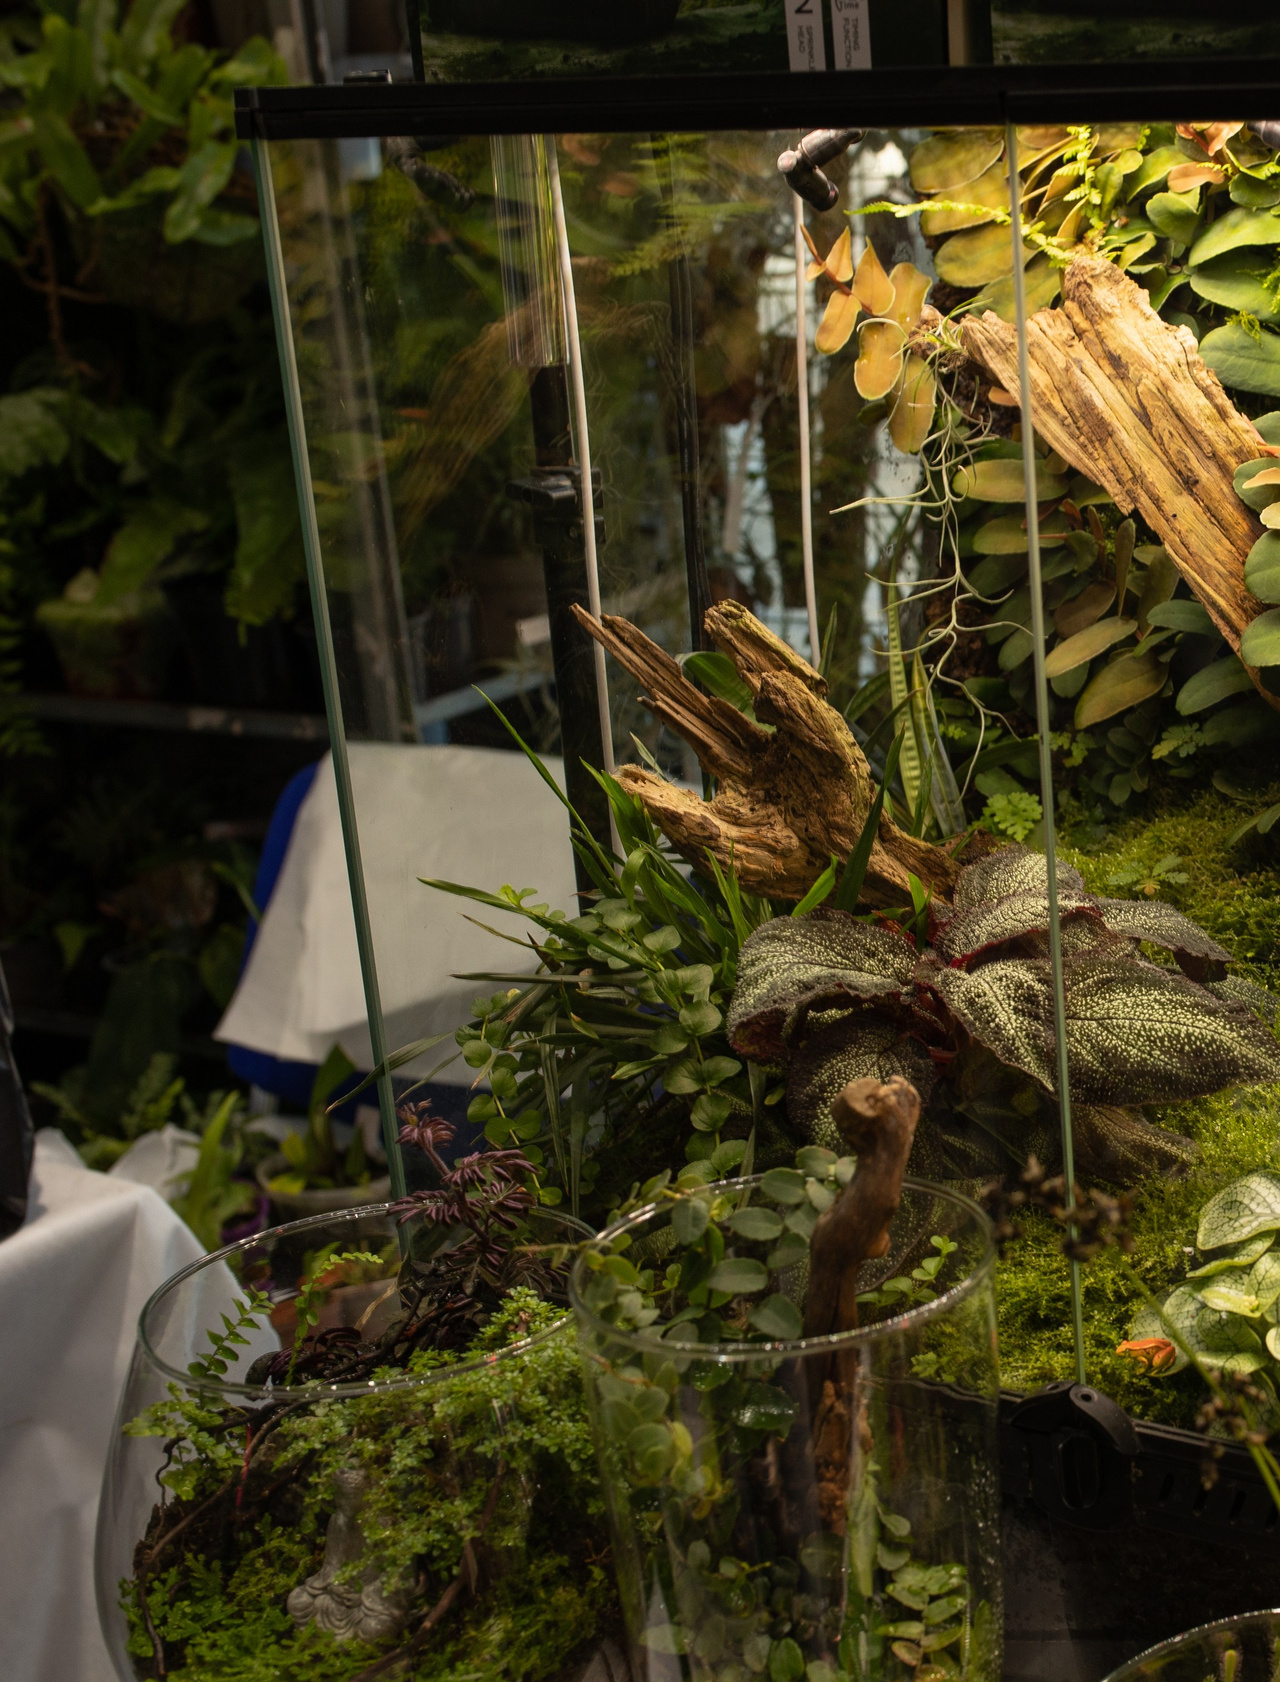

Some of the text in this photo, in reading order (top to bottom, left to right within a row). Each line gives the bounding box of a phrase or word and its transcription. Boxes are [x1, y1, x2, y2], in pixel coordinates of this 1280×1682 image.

[798, 25, 806, 54] HEAD
[806, 25, 816, 72] SPRINKLE
[843, 17, 852, 68] FUNCTION
[852, 17, 860, 51] TIMING
